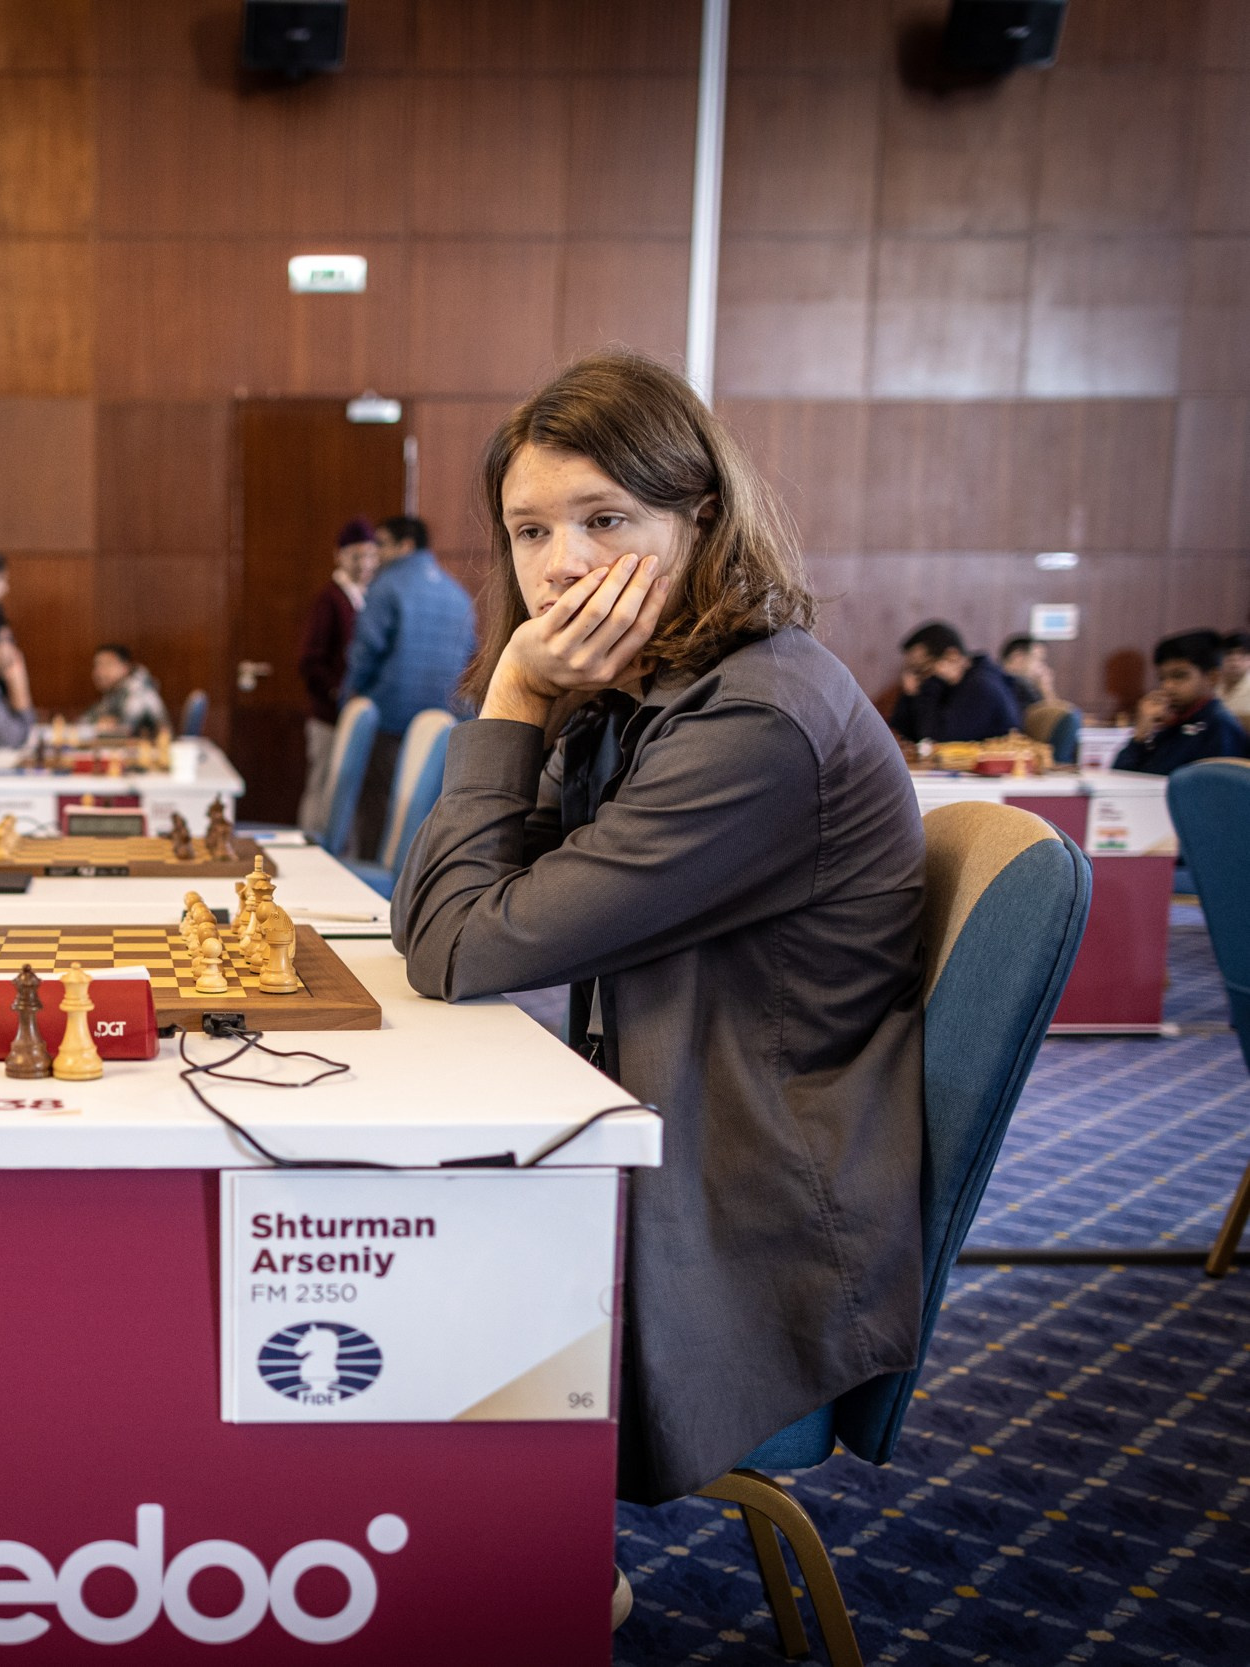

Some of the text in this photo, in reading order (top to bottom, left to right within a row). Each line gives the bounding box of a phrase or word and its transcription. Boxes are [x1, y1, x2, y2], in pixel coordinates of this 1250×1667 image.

[97, 1021, 126, 1037] DGT
[252, 1213, 435, 1239] Shturman
[251, 1246, 395, 1278] Arseniy
[250, 1284, 358, 1304] FM 2350
[302, 1393, 335, 1406] FIDE
[567, 1393, 595, 1409] 96
